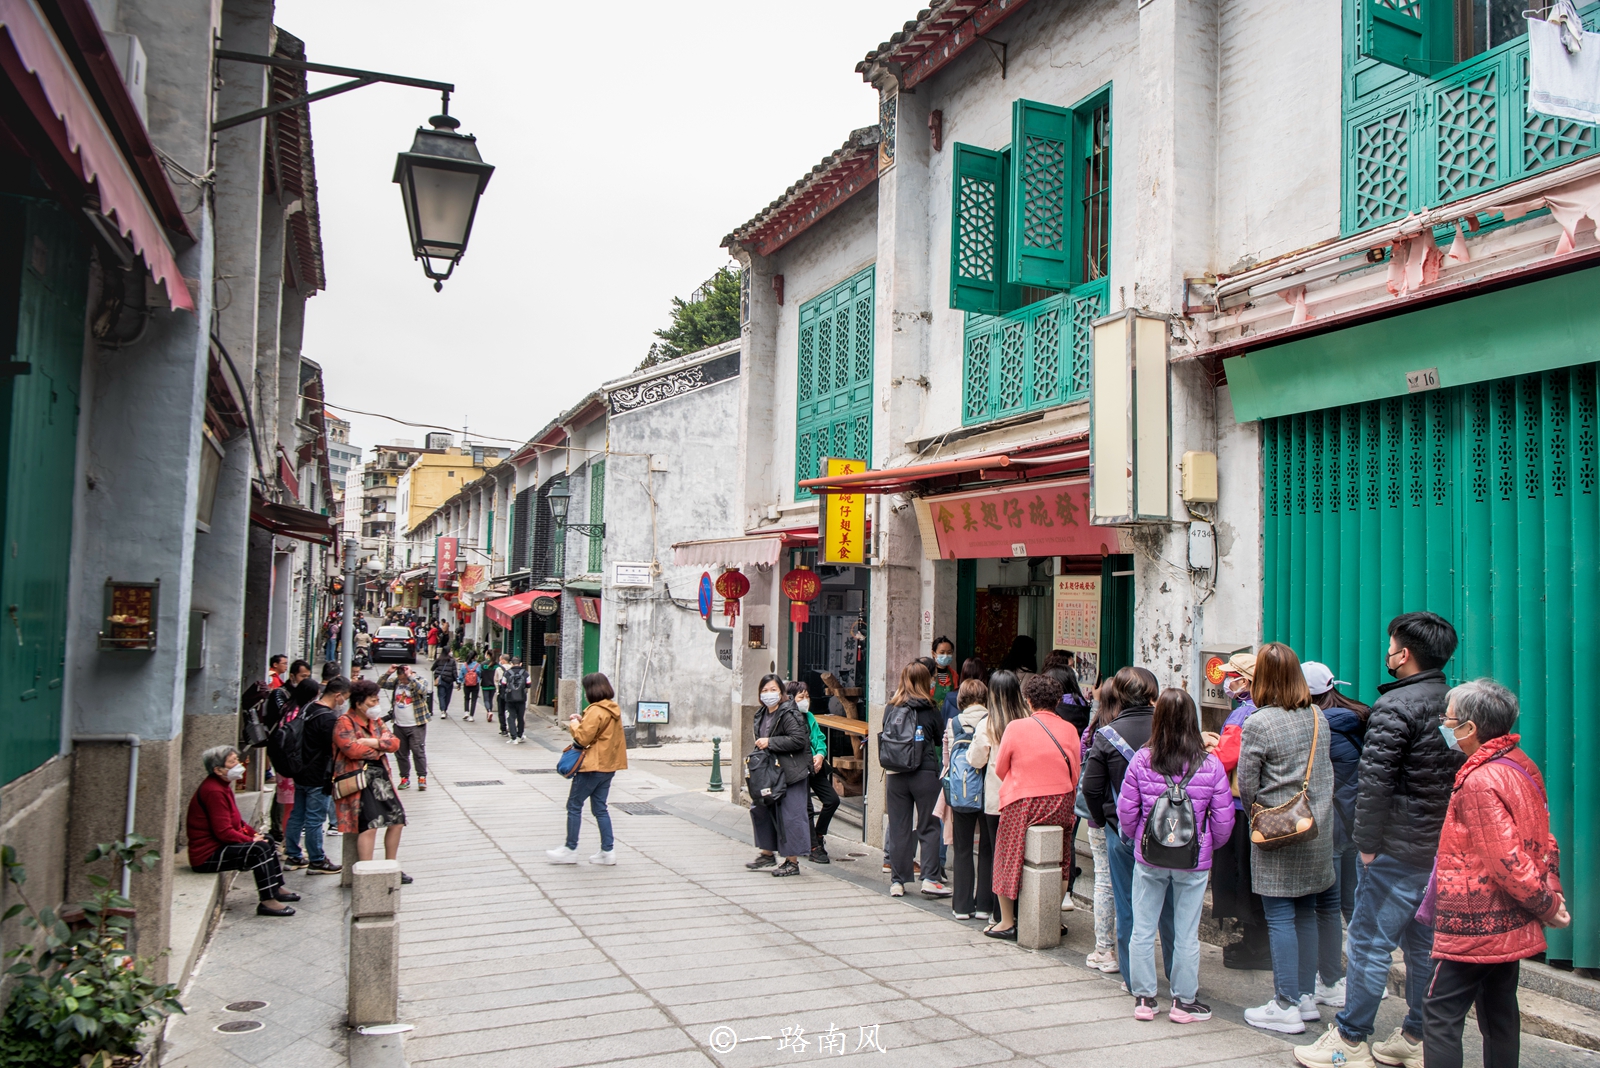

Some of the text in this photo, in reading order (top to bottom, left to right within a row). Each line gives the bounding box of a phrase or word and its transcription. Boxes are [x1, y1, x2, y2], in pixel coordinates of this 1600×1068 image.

[1423, 371, 1435, 386] 16
[836, 463, 854, 559] 添碗仔翅美食
[1191, 529, 1211, 538] 4734
